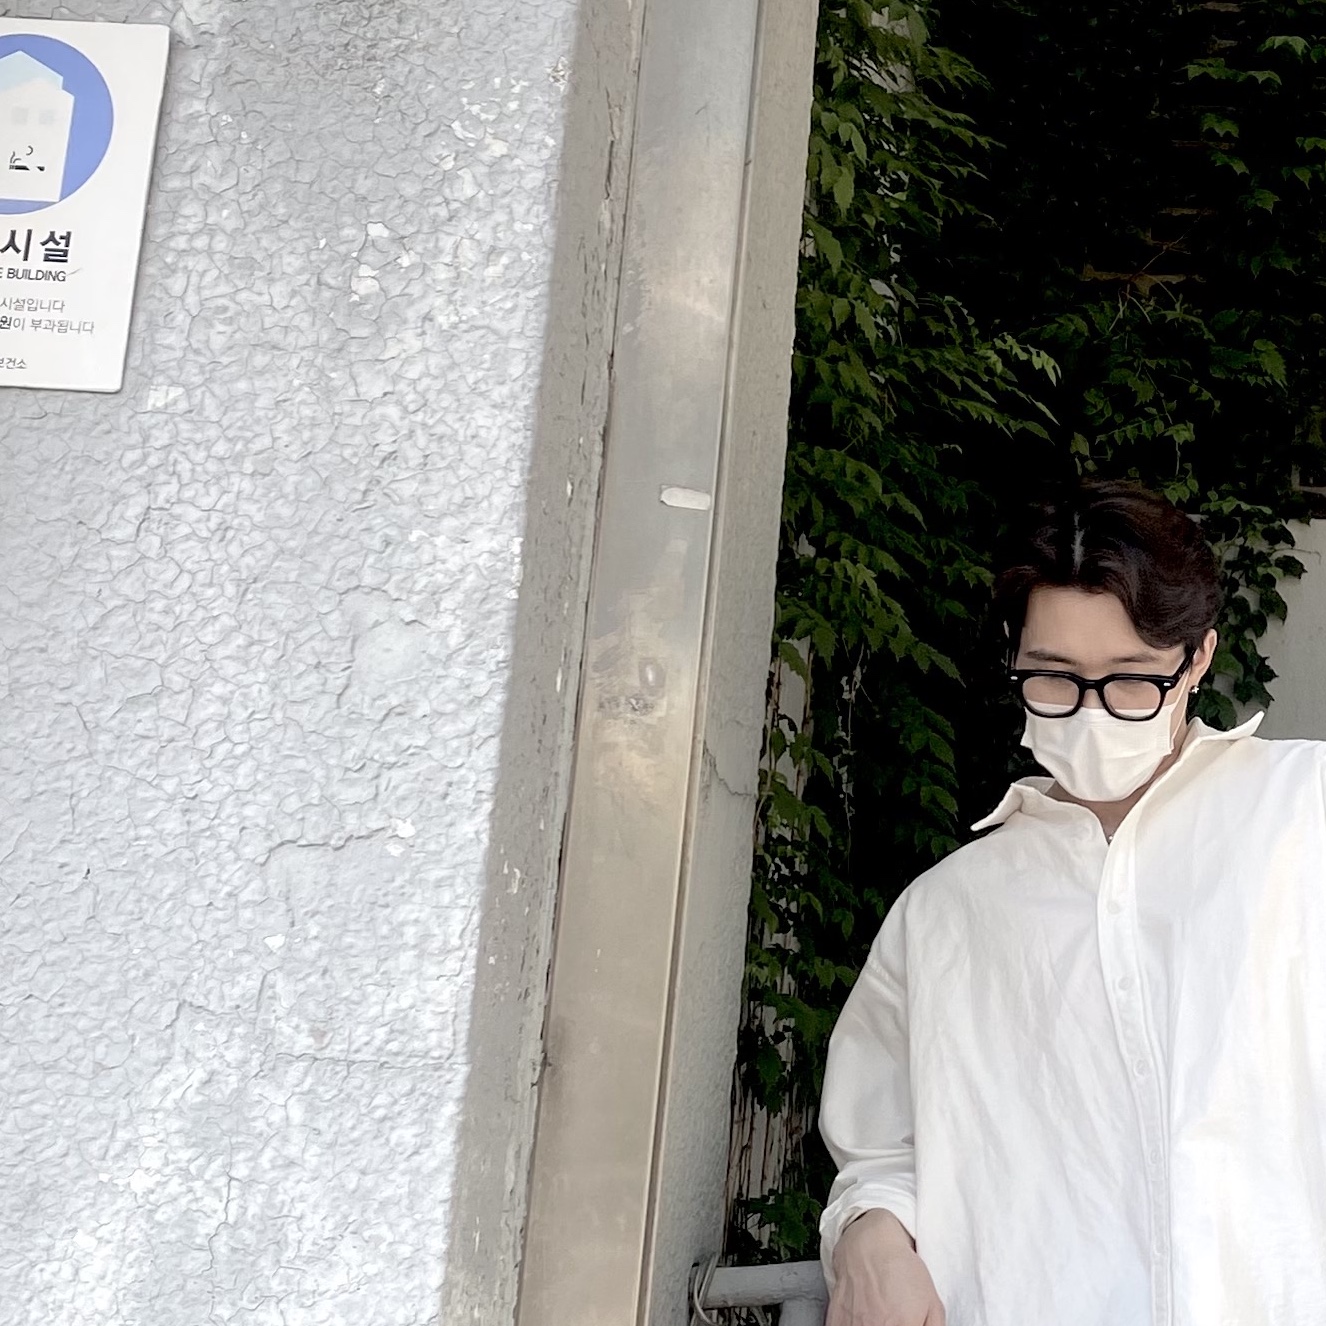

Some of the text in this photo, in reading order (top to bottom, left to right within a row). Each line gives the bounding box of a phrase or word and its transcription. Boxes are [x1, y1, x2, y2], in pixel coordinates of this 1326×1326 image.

[6, 267, 67, 282] BUILDING
[0, 297, 65, 313] 시설입니다
[30, 317, 94, 334] 부과됩니다
